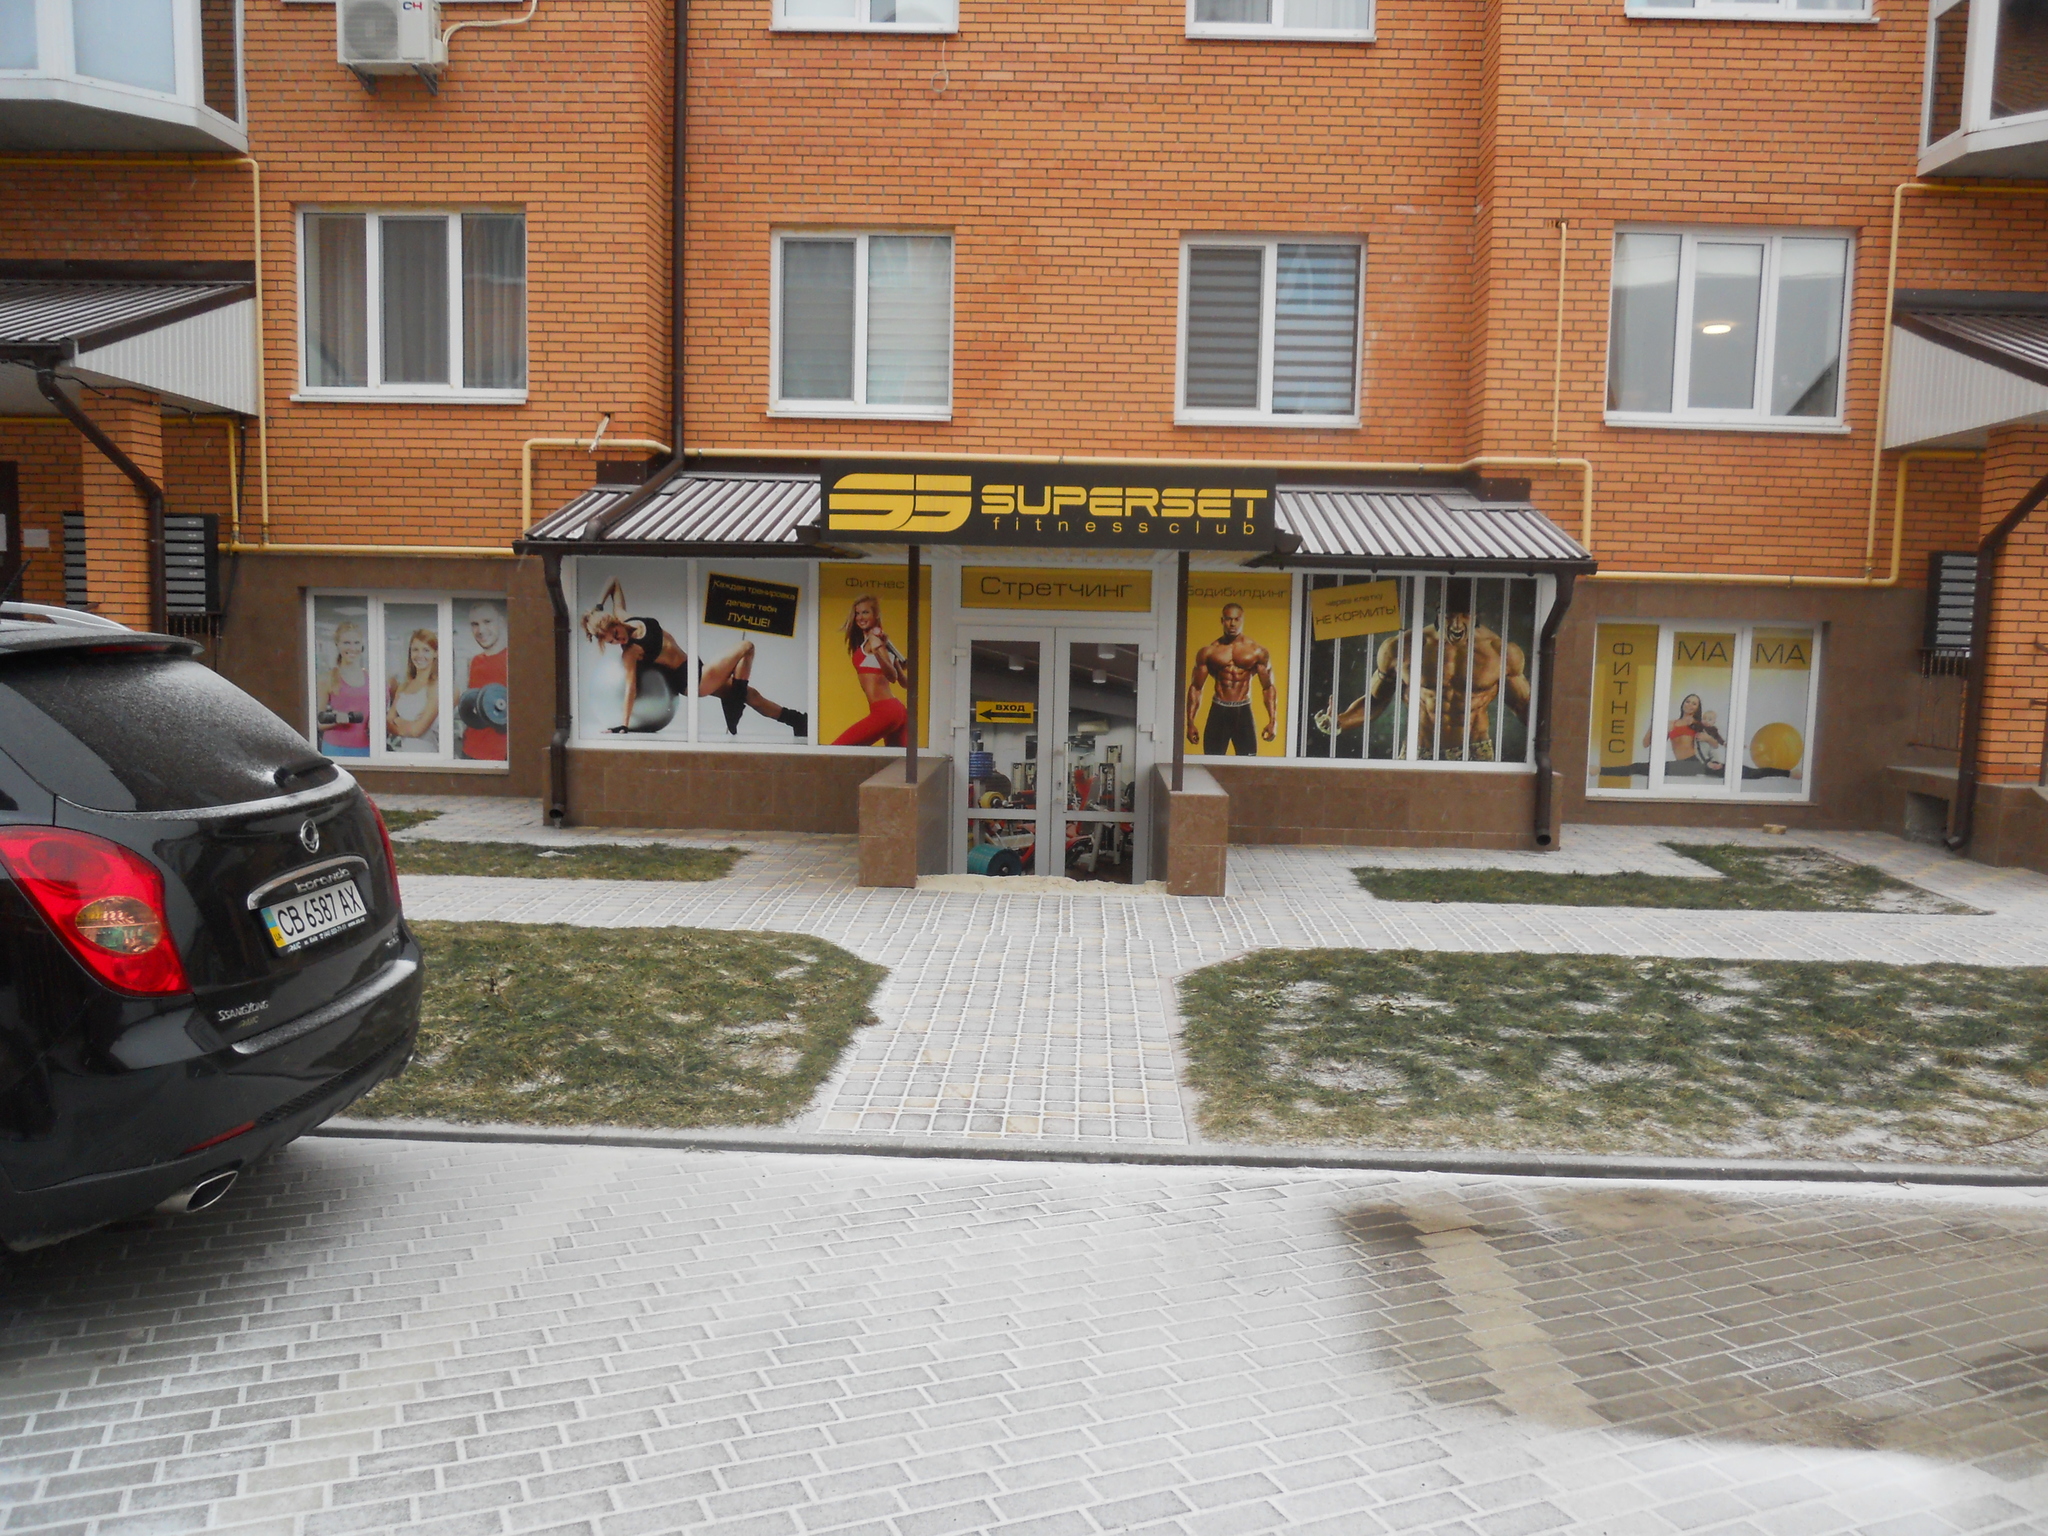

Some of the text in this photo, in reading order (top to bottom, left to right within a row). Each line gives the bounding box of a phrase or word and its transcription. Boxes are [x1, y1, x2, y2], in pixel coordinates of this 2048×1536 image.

[980, 484, 1268, 519] SUPERSET
[845, 577, 905, 589] Фитнес
[980, 575, 1133, 600] Стретчинг
[727, 612, 771, 628] ЛУЧШЕ!
[1315, 614, 1332, 626] НЕ
[277, 905, 305, 937] CB
[304, 892, 338, 928] 6587
[337, 885, 362, 917] AX
